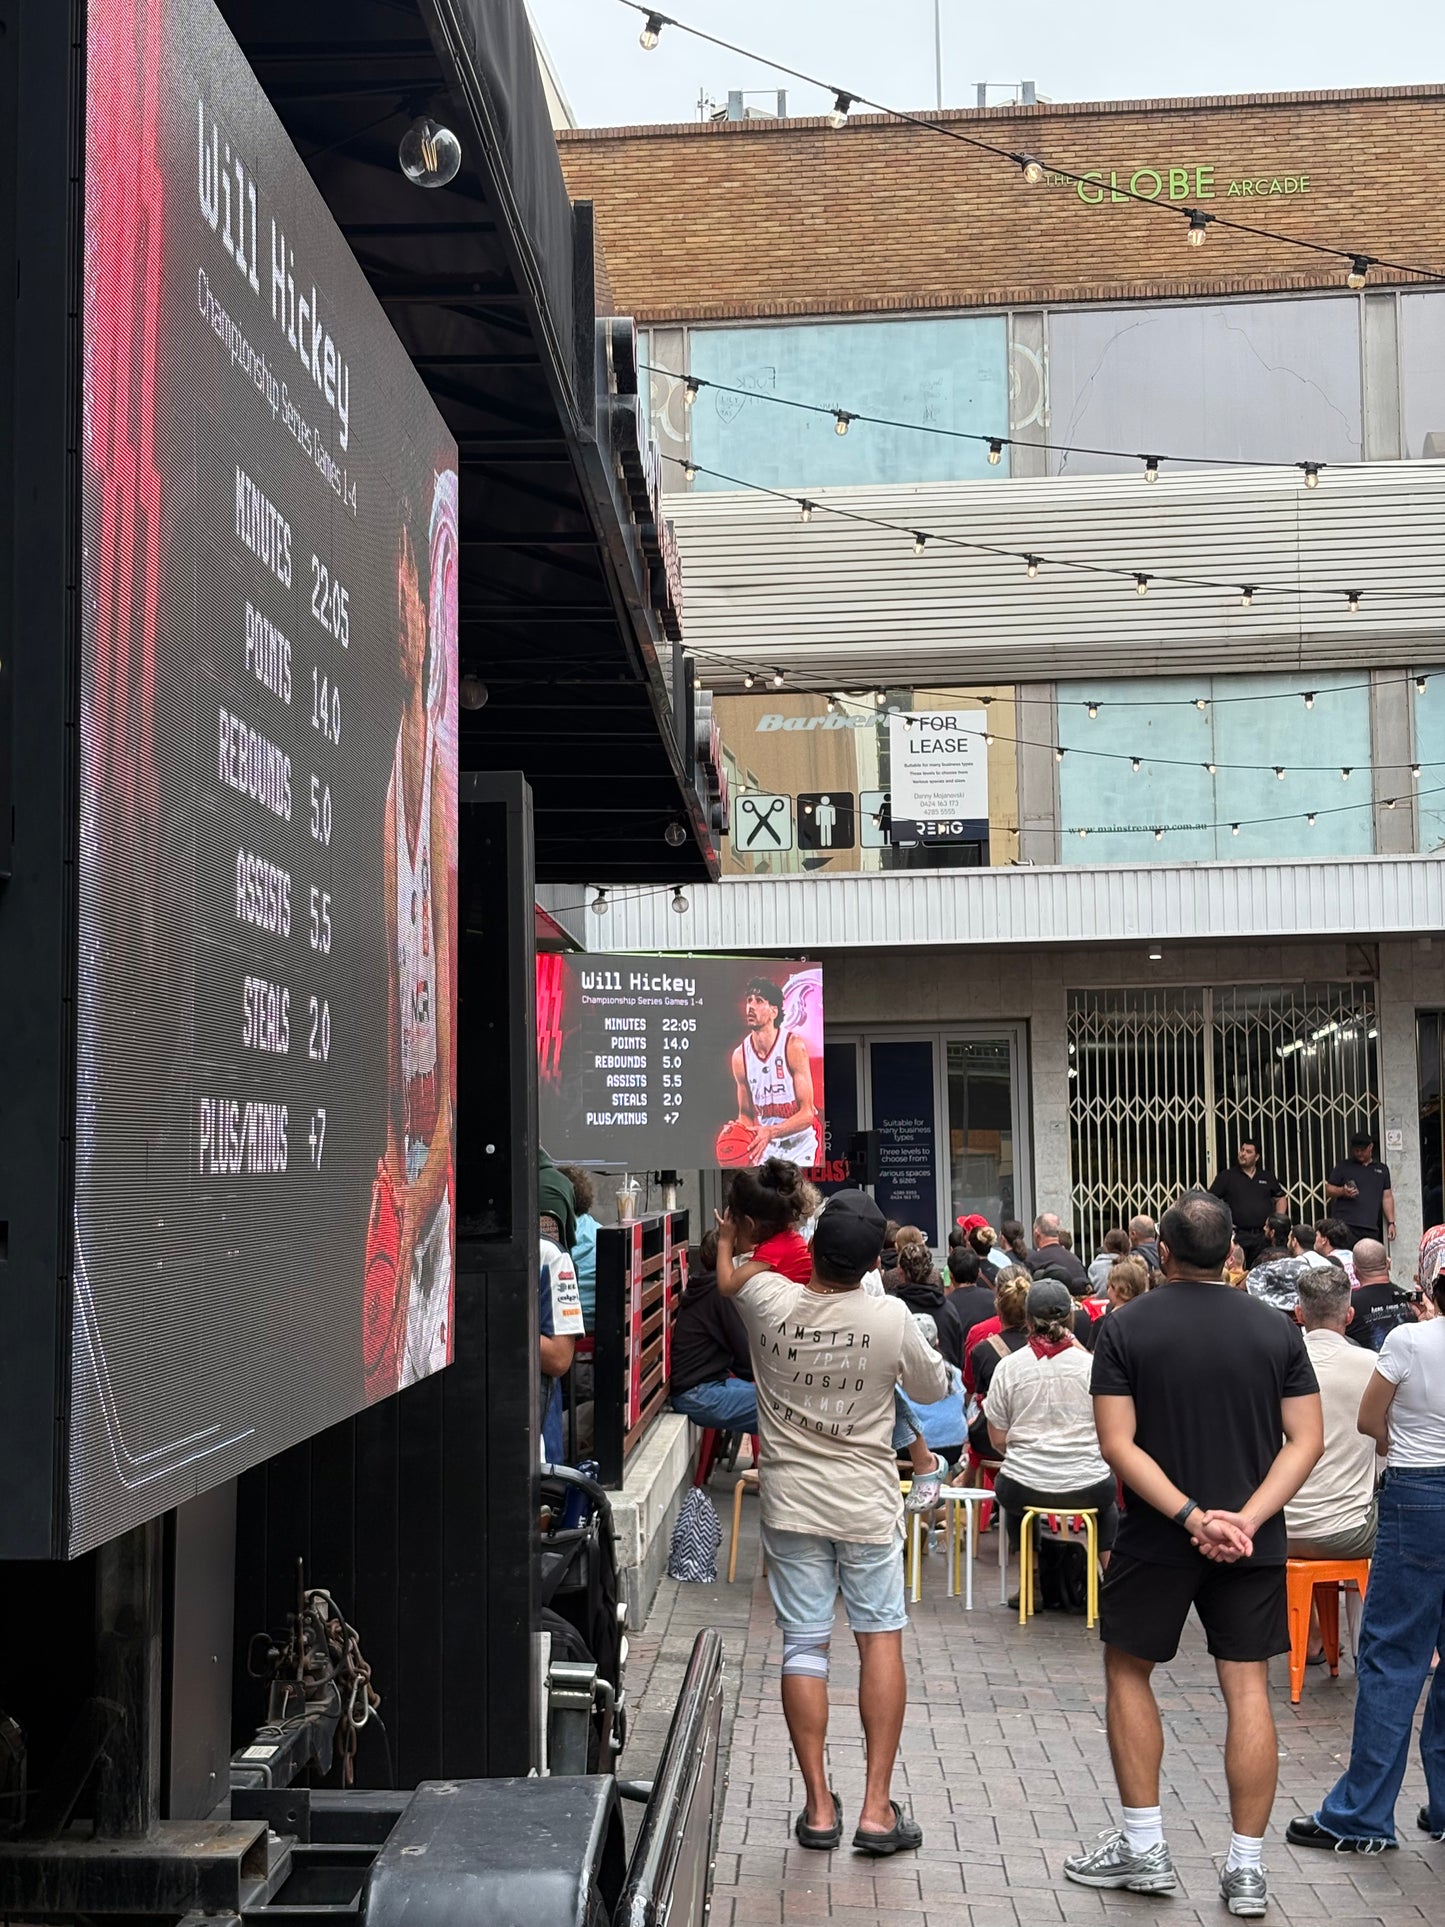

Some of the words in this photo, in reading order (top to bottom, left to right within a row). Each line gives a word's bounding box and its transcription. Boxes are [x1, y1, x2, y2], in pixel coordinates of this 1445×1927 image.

[1043, 174, 1074, 186] THE
[1077, 166, 1215, 204] GLOBE
[1227, 176, 1310, 197] ARCADE
[199, 98, 259, 296] Will
[271, 216, 349, 452] Hickey
[198, 267, 280, 420] Championship
[281, 382, 312, 457] Series
[314, 427, 342, 496] Games
[343, 468, 357, 516] 1-4
[236, 465, 292, 589] MINUTES
[312, 554, 349, 649] 22:05
[246, 601, 292, 705] POINTS
[312, 666, 340, 745] 14.0
[755, 706, 900, 732] Barberi
[920, 716, 957, 731] FOR
[910, 738, 968, 754] LEASE
[219, 706, 291, 821] REBOUNDS
[311, 774, 331, 846] 5.0
[237, 847, 291, 938] ASSISTS
[311, 885, 331, 954] 5.5
[581, 971, 622, 990] Will
[630, 972, 696, 996] Hickey
[581, 995, 636, 1005] Championship
[638, 997, 663, 1006] Series
[664, 997, 688, 1006] Games
[691, 998, 703, 1006] 1-4
[243, 975, 290, 1054] STEALS
[309, 996, 331, 1062] 2.0
[604, 1017, 646, 1031] MINUTES
[662, 1018, 696, 1032] 22:05
[611, 1036, 647, 1049] POINTS
[663, 1037, 689, 1050] 14.0
[595, 1055, 647, 1068] REBOUNDS
[662, 1056, 682, 1068] 5.0
[606, 1074, 647, 1087] ASSISTS
[662, 1075, 682, 1087] 5.5
[612, 1093, 648, 1106] STEALS
[663, 1093, 682, 1106] 2.0
[586, 1112, 648, 1125] PLUS/MINUS
[664, 1112, 680, 1125] +7
[200, 1098, 288, 1174] PLUS/MINUS
[309, 1108, 326, 1171] +7
[894, 1134, 914, 1142] types
[803, 1160, 850, 1182] LEAS
